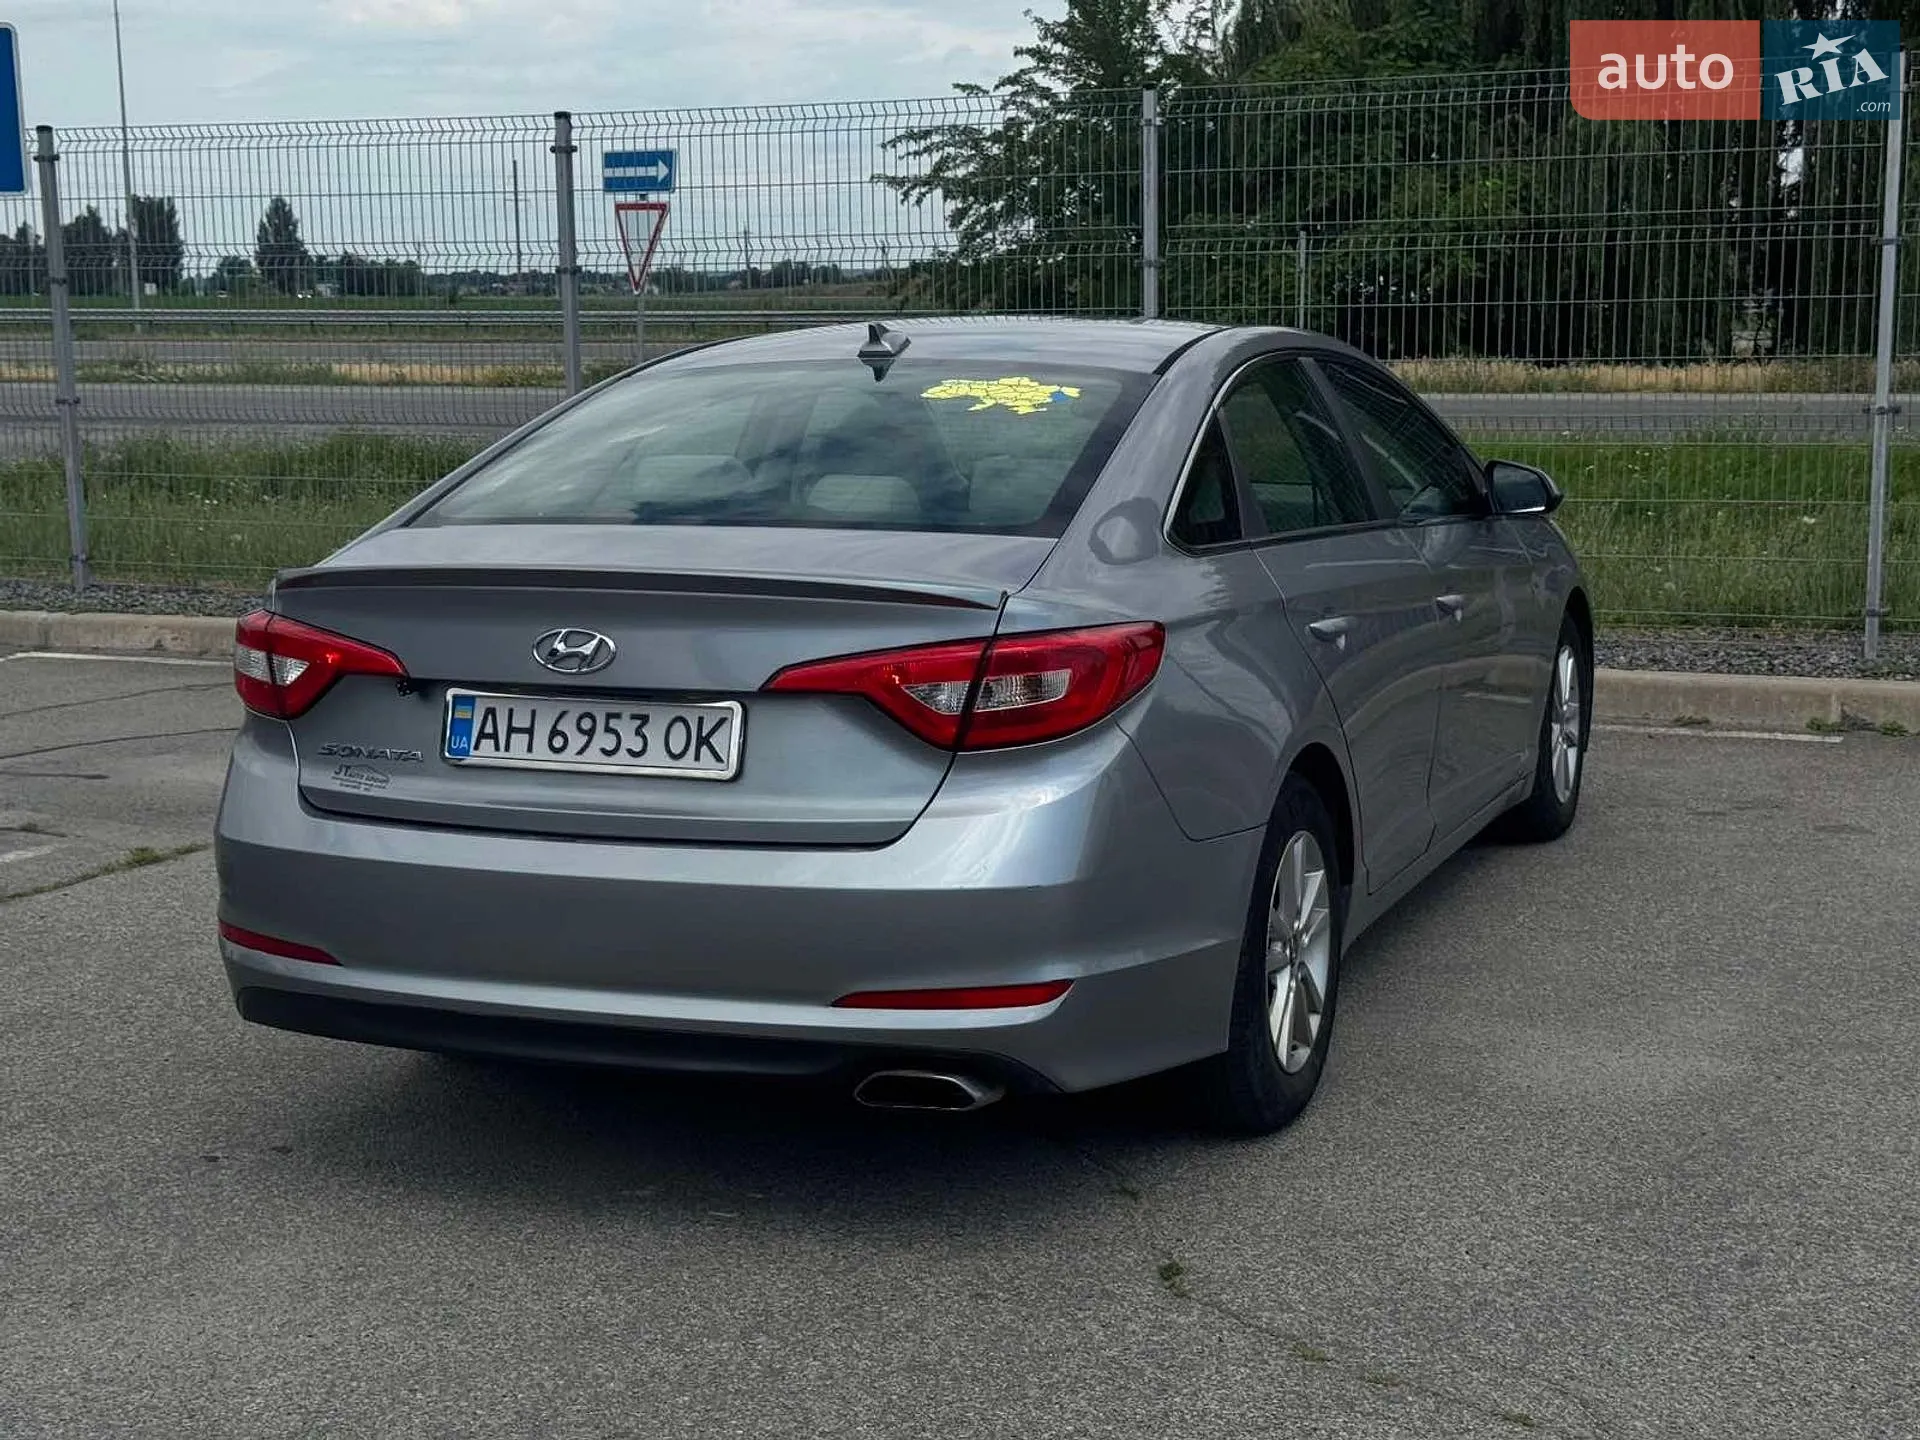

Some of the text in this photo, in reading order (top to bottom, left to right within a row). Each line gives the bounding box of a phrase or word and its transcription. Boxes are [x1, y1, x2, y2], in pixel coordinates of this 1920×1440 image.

[451, 735, 469, 750] UA
[473, 706, 729, 763] AH 6953 OK
[318, 743, 424, 762] SONATA
